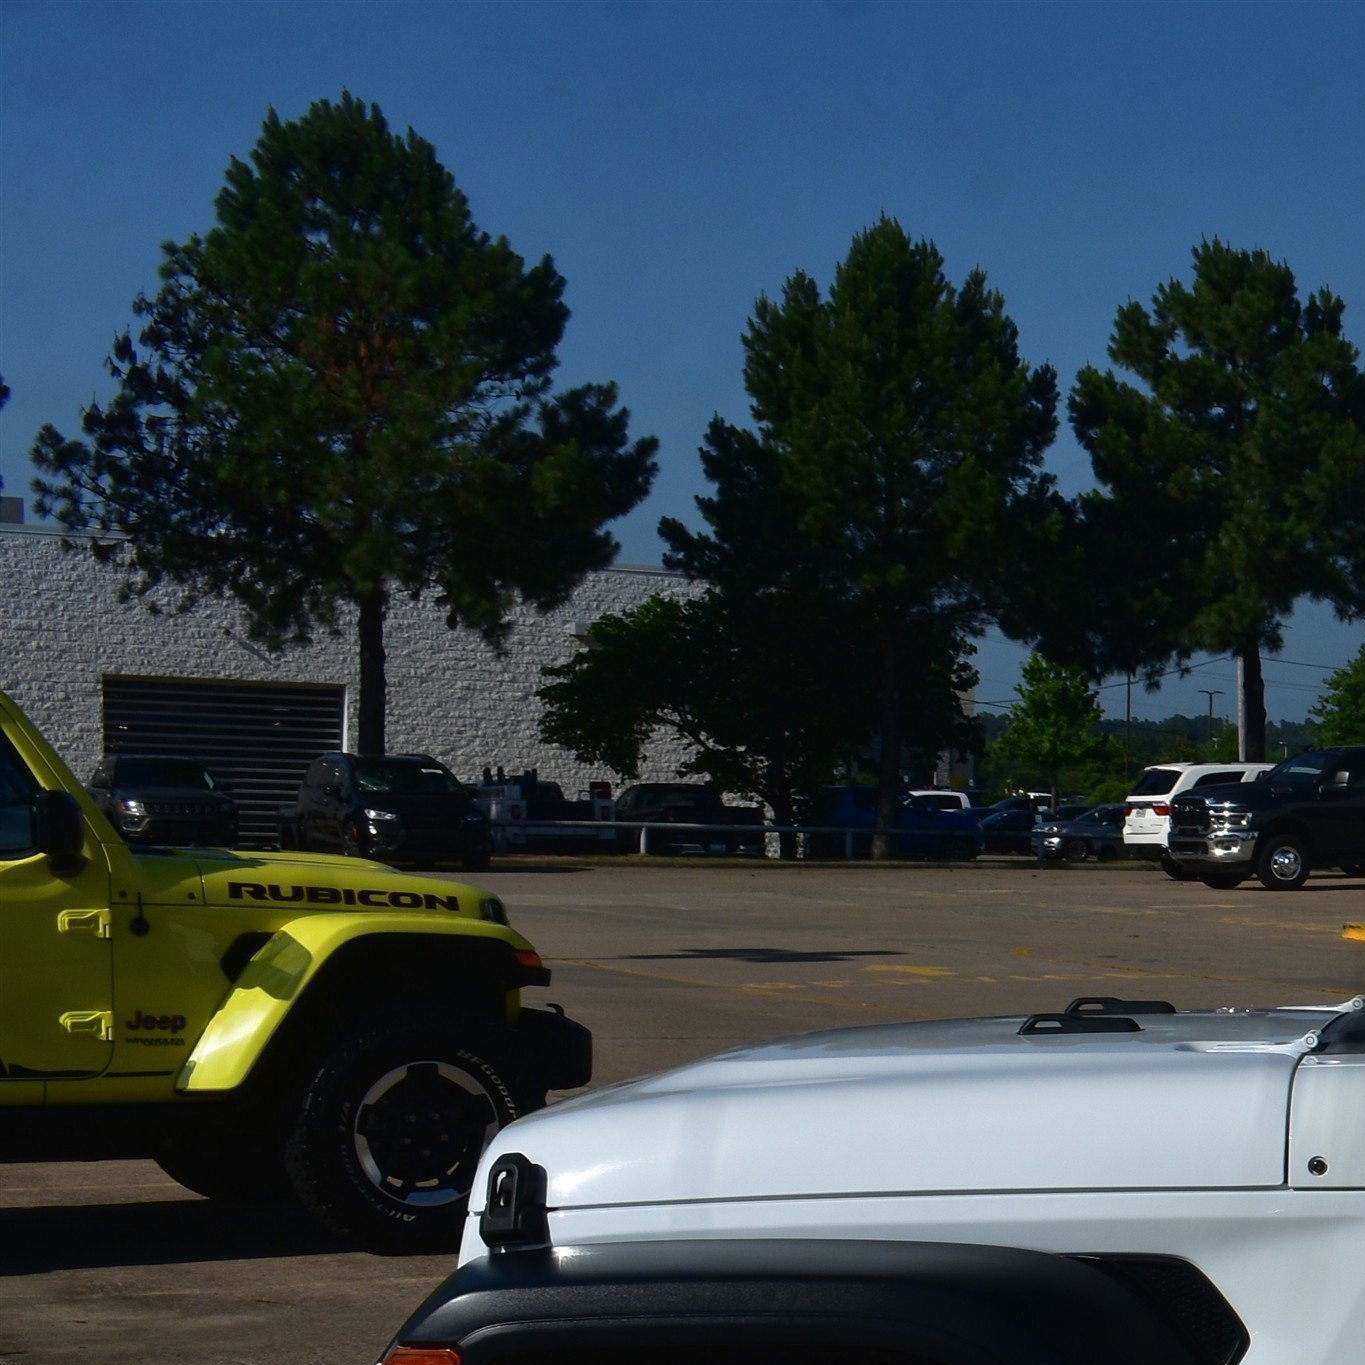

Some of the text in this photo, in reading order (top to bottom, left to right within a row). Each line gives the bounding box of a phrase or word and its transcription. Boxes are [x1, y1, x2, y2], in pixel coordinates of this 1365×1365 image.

[227, 882, 461, 911] RUBICON
[125, 1010, 186, 1034] Jeep
[456, 1048, 517, 1120] BFGoodr
